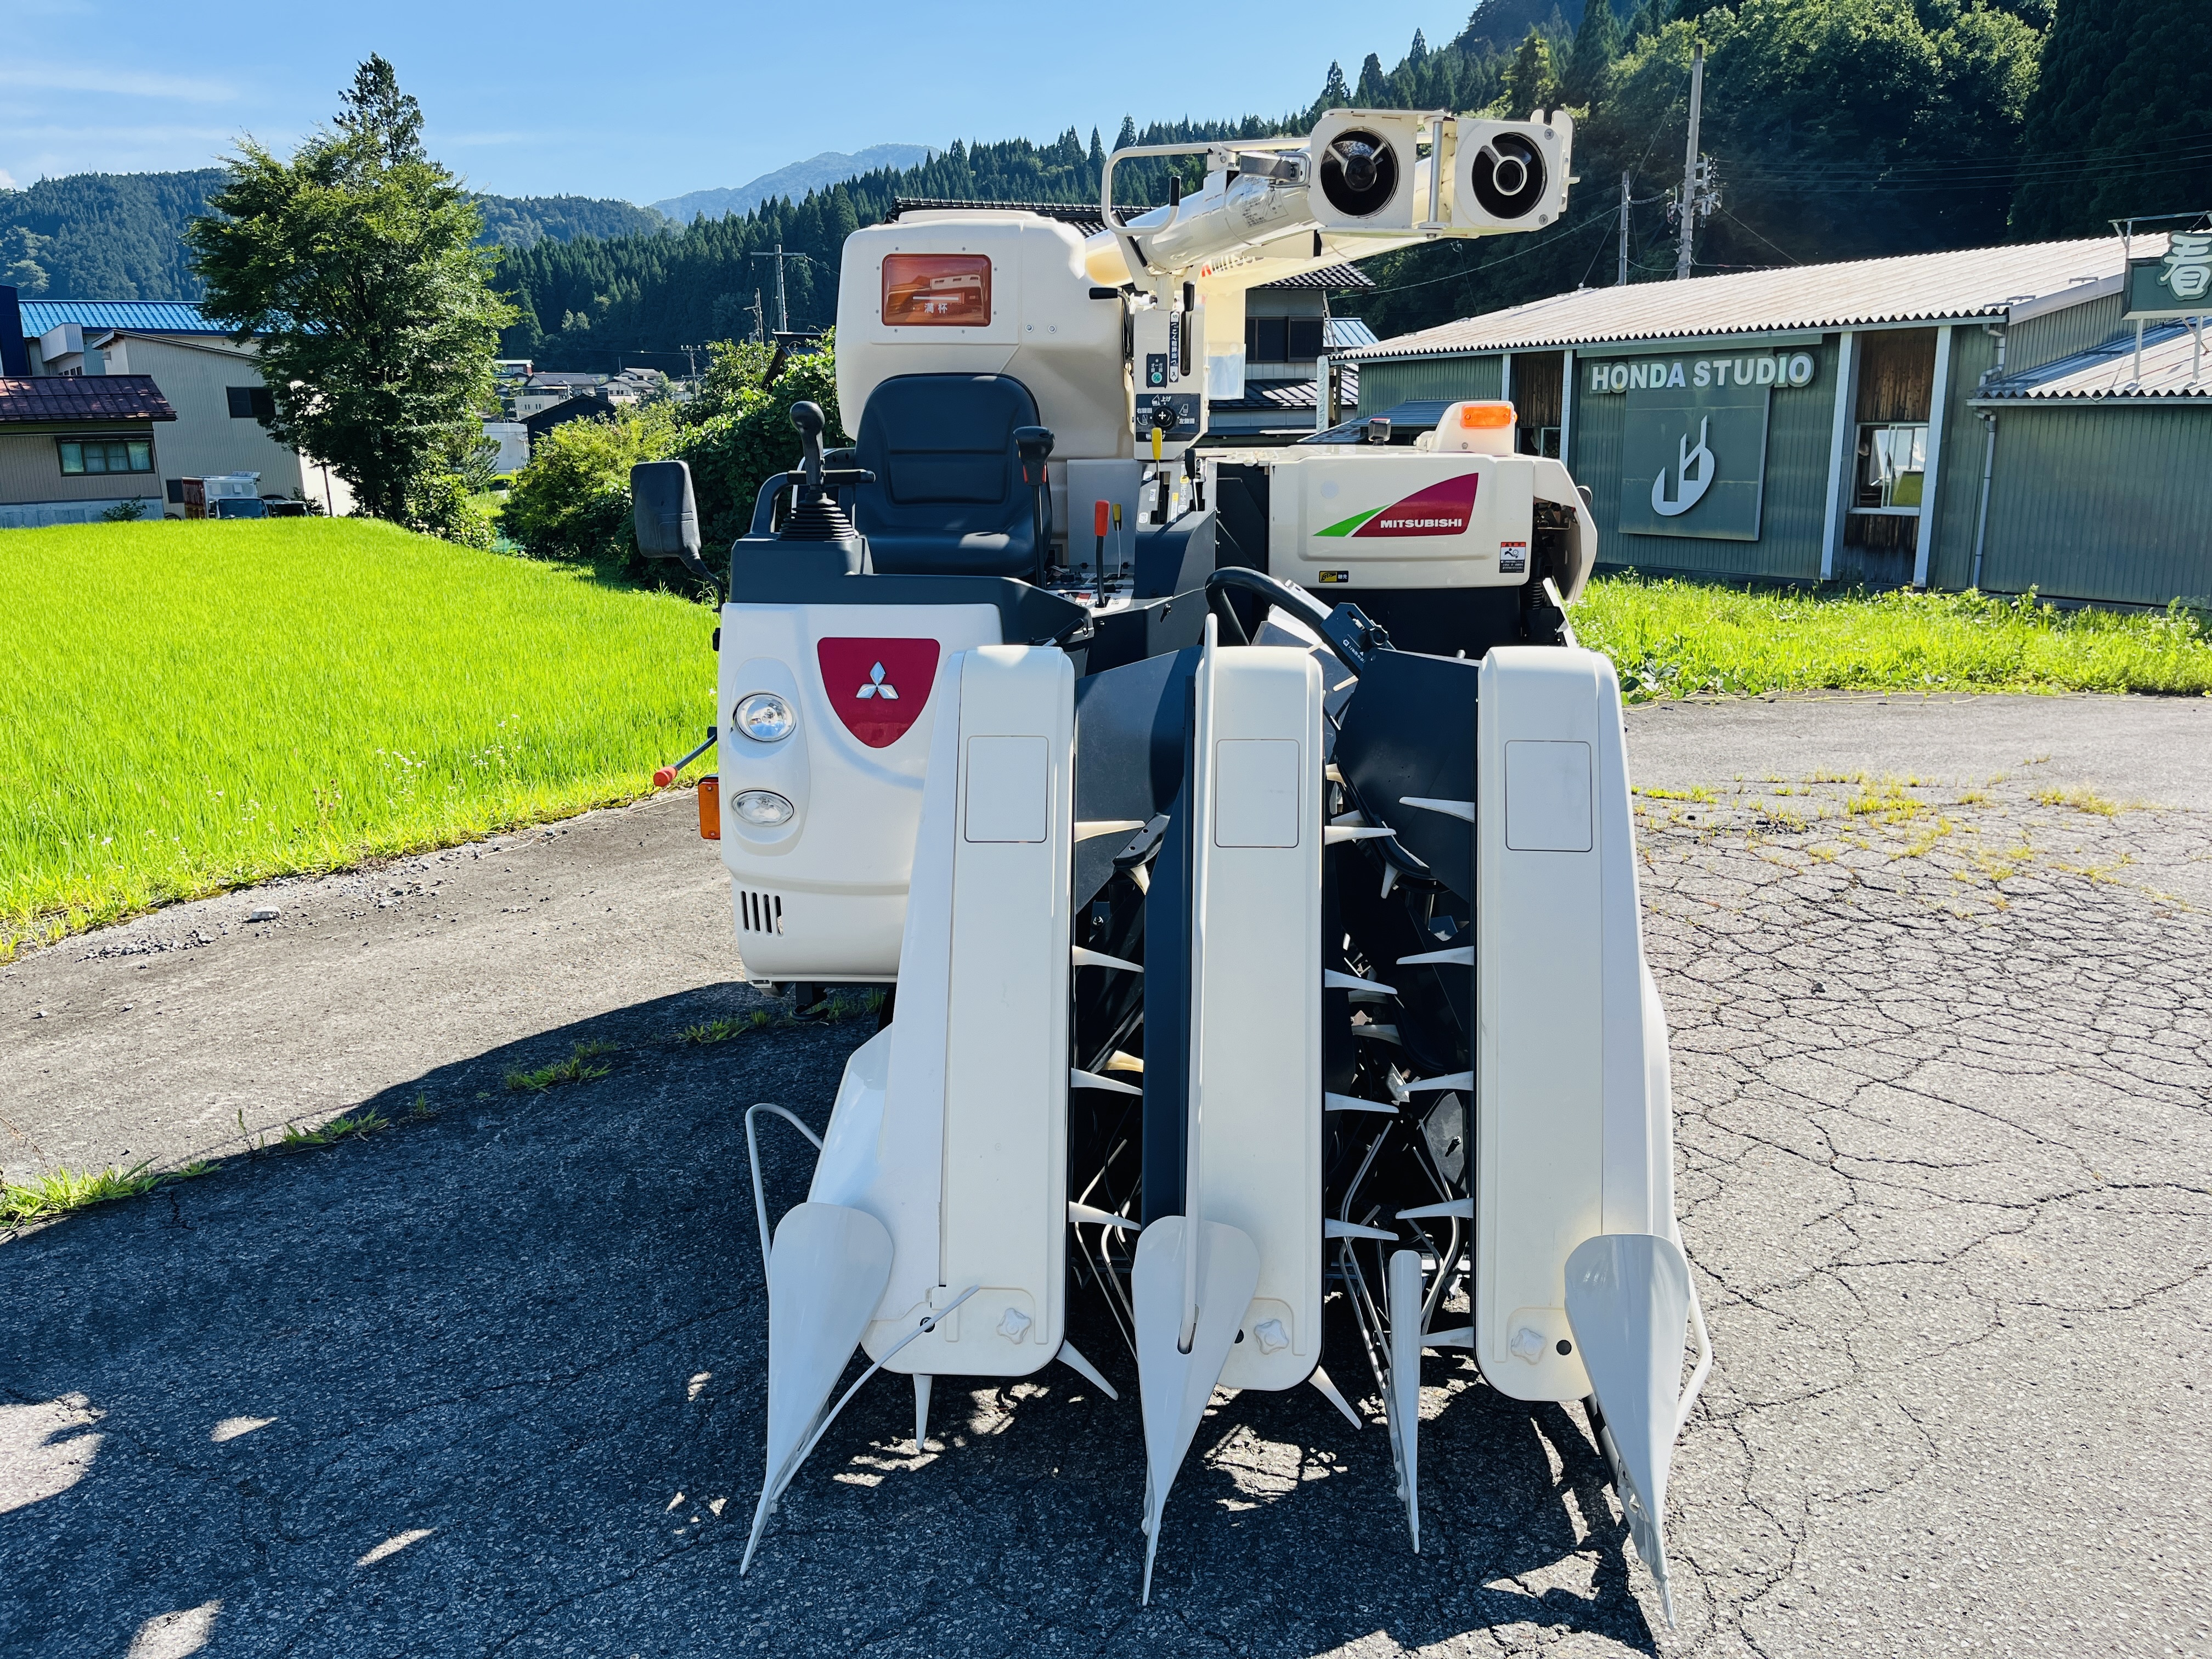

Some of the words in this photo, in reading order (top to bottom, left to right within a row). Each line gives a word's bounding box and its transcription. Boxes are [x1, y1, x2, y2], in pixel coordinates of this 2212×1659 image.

[2160, 234, 2212, 297] 看
[924, 303, 948, 314] 満杯
[1592, 363, 1686, 390] HONDA
[1693, 356, 1811, 387] STUDIO
[1380, 518, 1462, 528] MITSUBISHI
